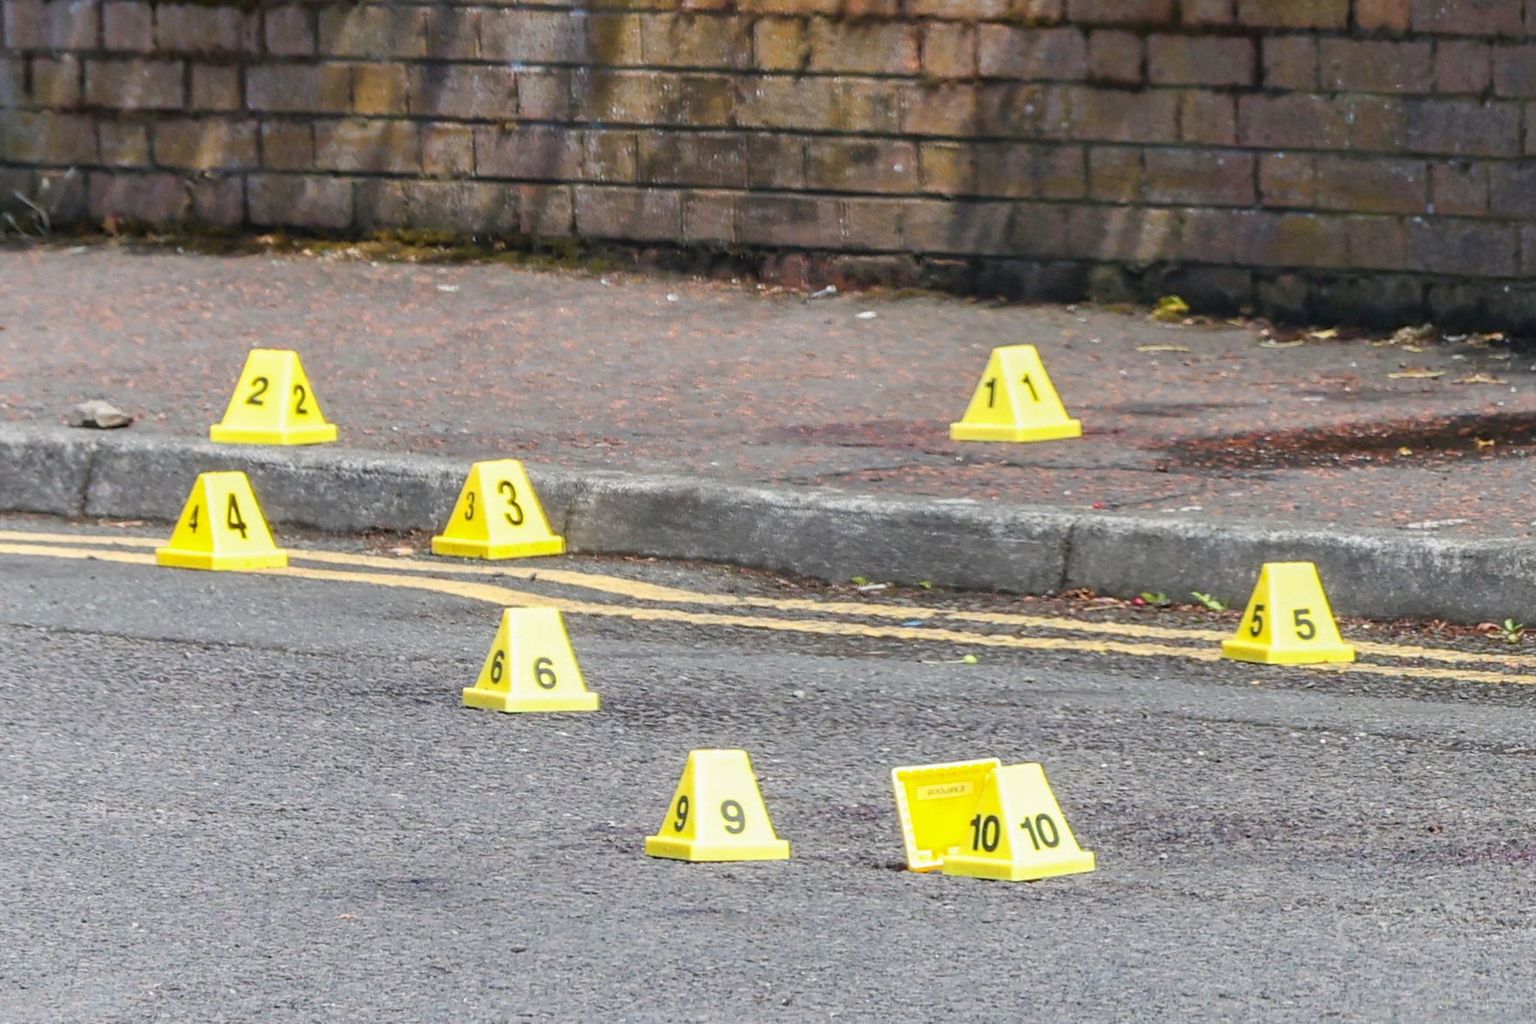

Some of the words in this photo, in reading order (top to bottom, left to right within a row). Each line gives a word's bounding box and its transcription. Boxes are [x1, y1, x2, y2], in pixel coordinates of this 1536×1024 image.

[246, 376, 270, 406] 2
[293, 384, 309, 415] 2
[985, 377, 997, 408] 1
[1021, 373, 1040, 402] 1
[188, 504, 200, 534] 4
[226, 493, 248, 539] 4
[464, 491, 476, 521] 3
[497, 479, 524, 526] 3
[1250, 604, 1264, 638] 5
[1293, 608, 1316, 641] 5
[489, 650, 505, 684] 6
[533, 657, 557, 689] 6
[673, 795, 689, 833] 9
[720, 799, 746, 834] 9
[970, 813, 1000, 853] 10
[1020, 812, 1060, 851] 10
